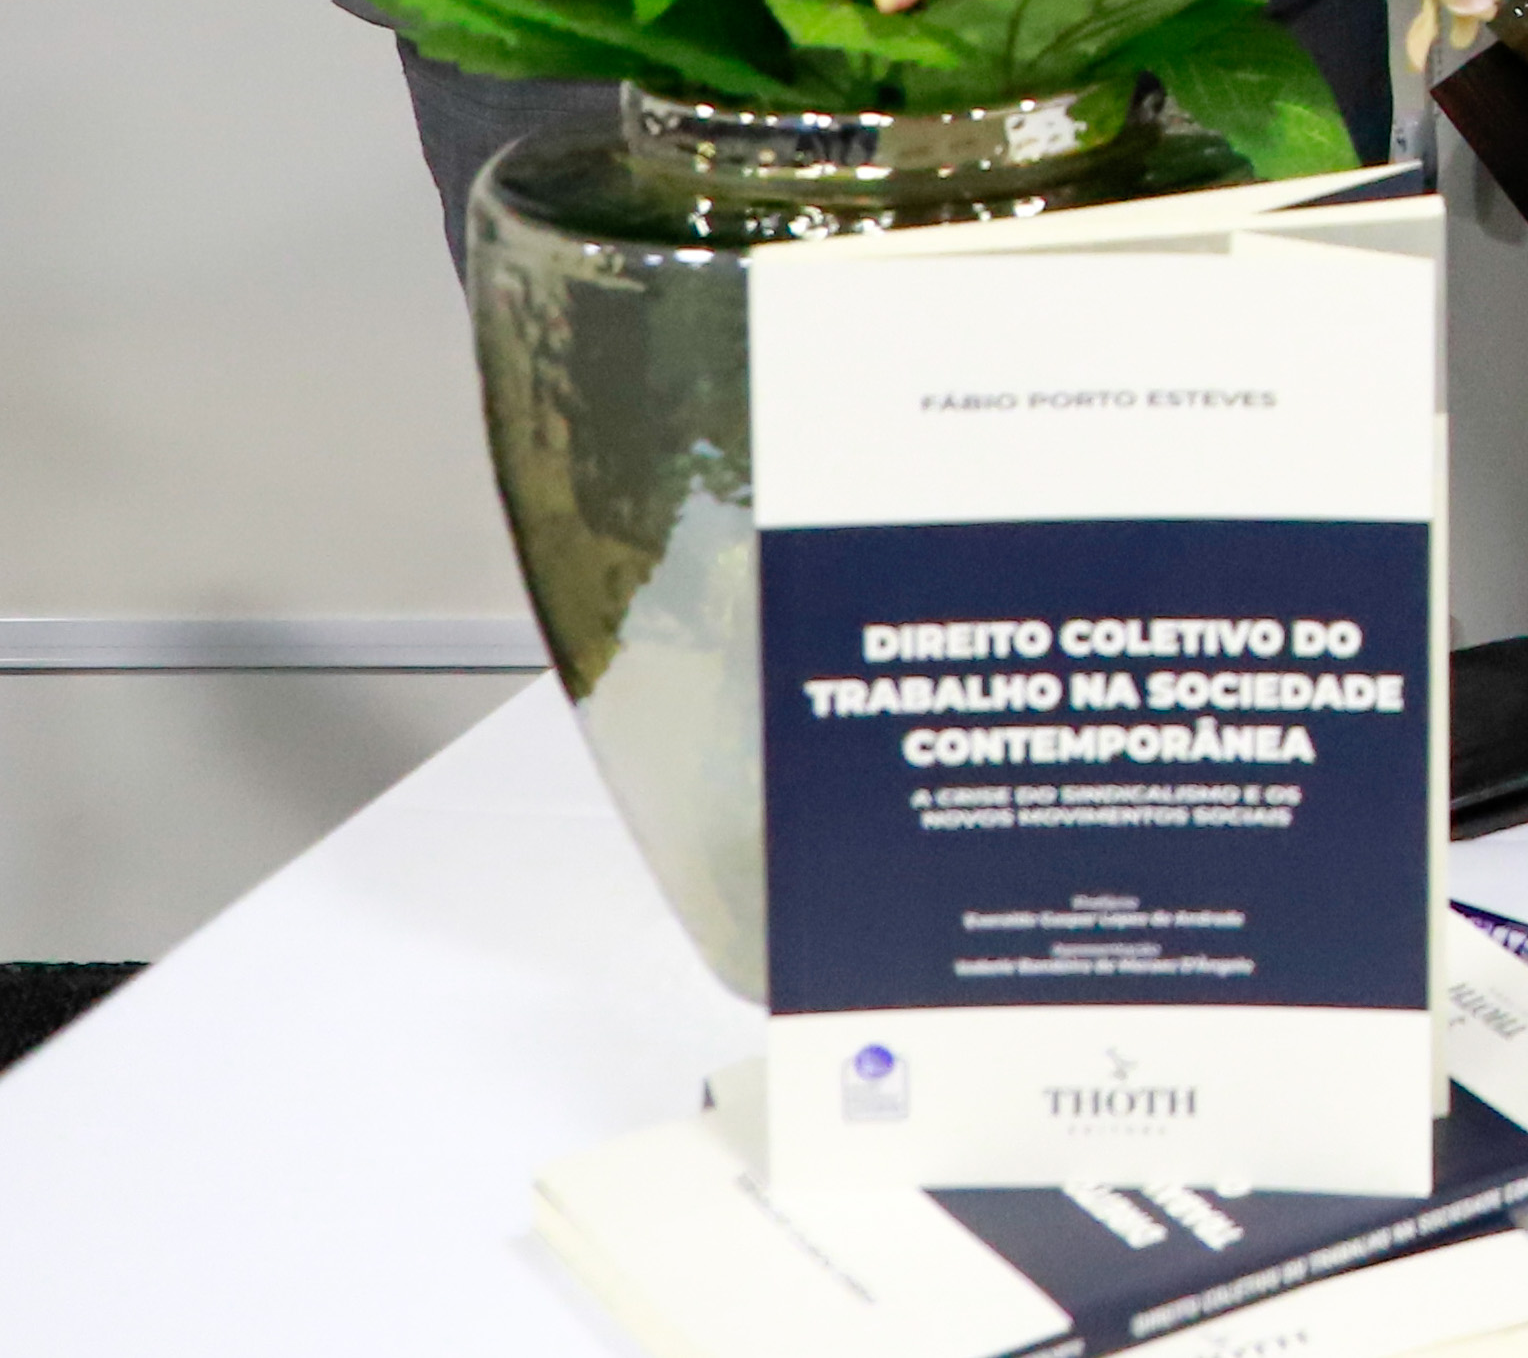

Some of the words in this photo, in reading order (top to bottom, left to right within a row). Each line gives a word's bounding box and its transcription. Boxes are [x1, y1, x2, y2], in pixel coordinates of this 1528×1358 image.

[919, 392, 1018, 411] FÁBIO
[1027, 390, 1137, 408] PORTO
[1145, 389, 1276, 407] ESTEVES
[863, 620, 1052, 662] DIREITO
[1059, 618, 1285, 657] COLETIVO
[1291, 619, 1362, 658] DO
[803, 672, 1062, 718] TRABALHO
[1069, 672, 1141, 710] NA
[1146, 671, 1404, 718] SOCIEDADE
[902, 715, 1316, 767] CONTEMPORÂNEA
[1046, 1088, 1196, 1116] THOTH
